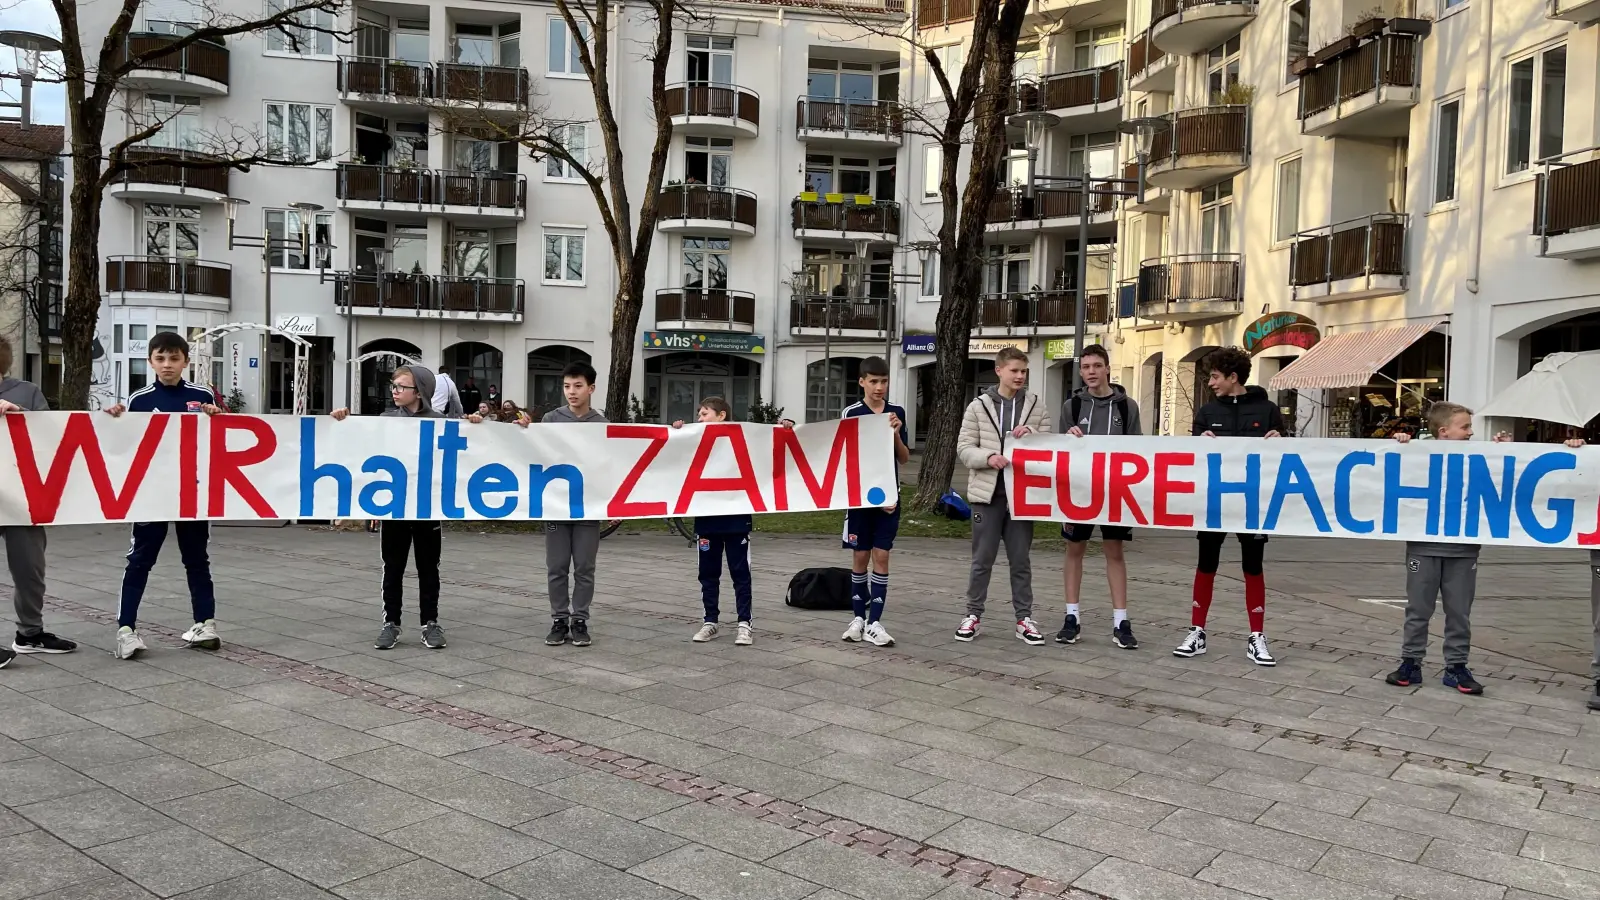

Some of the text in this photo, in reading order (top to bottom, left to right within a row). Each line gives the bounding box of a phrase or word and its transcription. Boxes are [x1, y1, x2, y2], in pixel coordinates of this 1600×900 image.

[665, 333, 691, 347] vhs
[1048, 341, 1065, 353] EMS
[6, 412, 886, 525] WIR halten ZAM.
[1012, 448, 1196, 528] EURE
[1206, 451, 1577, 544] HACHING
